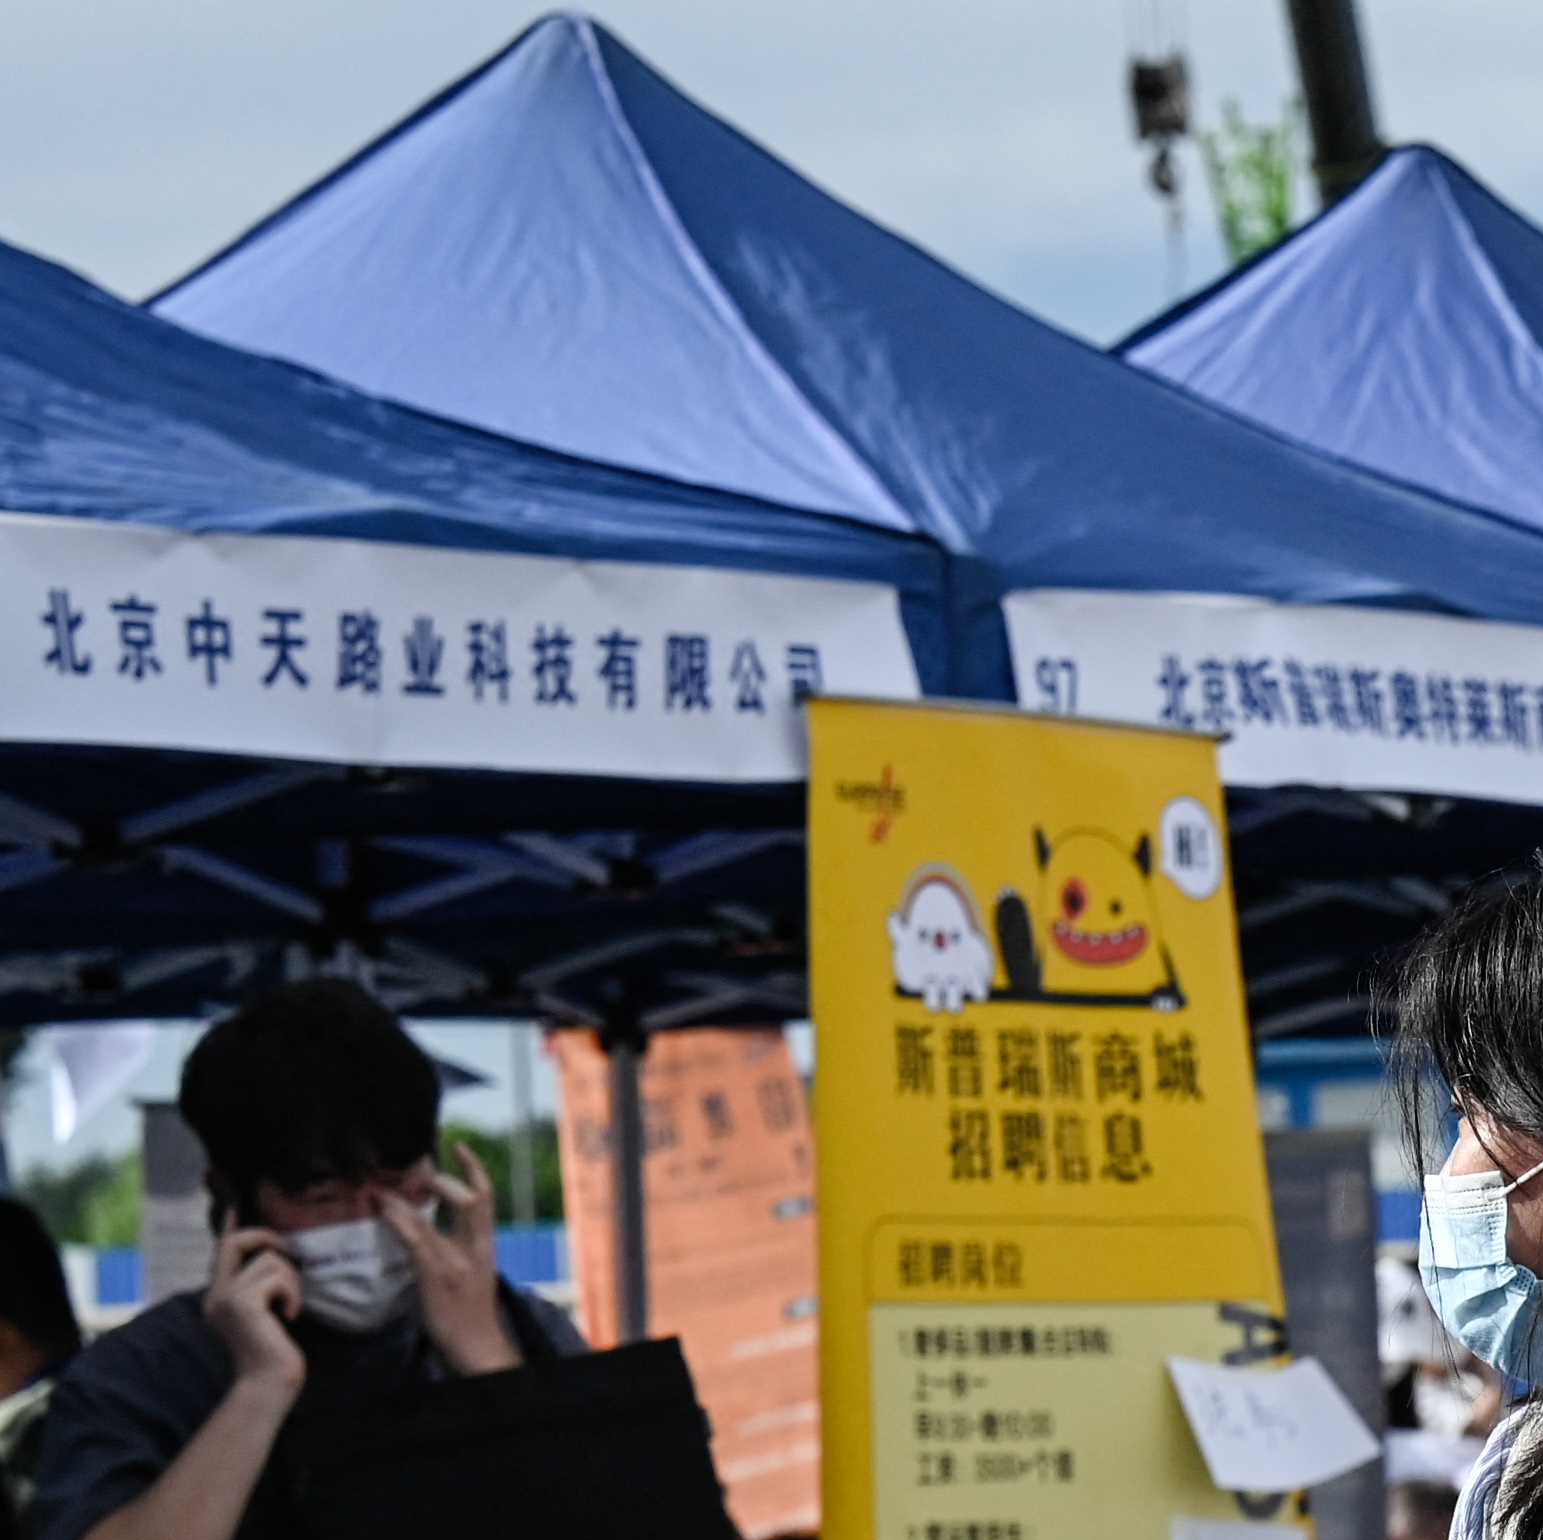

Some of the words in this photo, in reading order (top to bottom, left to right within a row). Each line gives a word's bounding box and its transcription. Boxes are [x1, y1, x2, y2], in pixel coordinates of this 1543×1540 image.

[1034, 656, 1078, 714] 97
[893, 1024, 1205, 1103] 斯普瑞斯商城
[948, 1109, 1151, 1184] 招聘信息
[898, 1240, 1023, 1289] 招聘岗位
